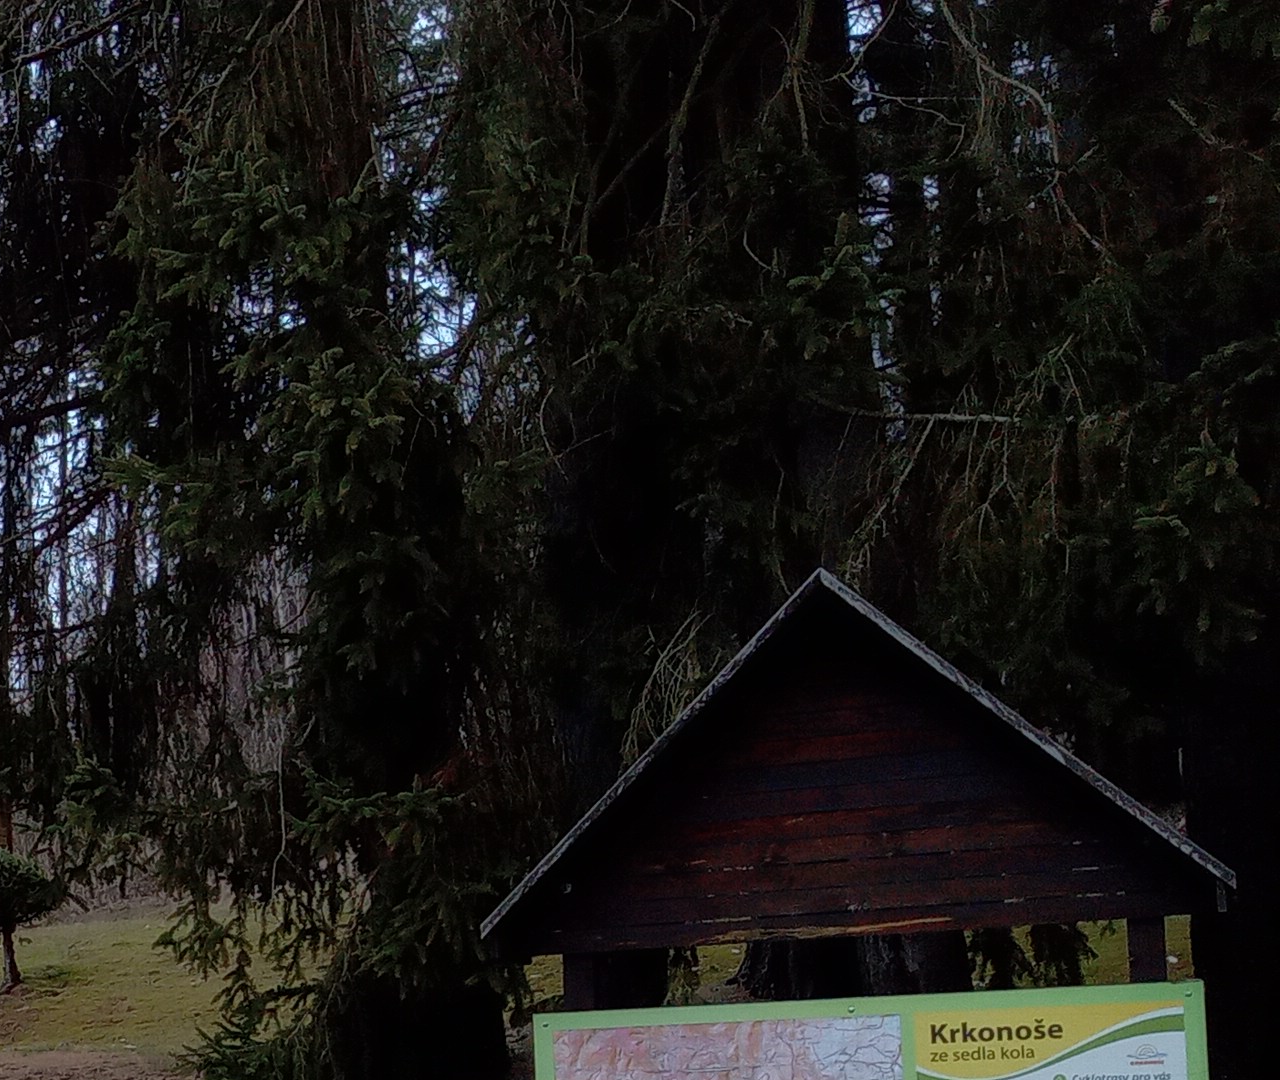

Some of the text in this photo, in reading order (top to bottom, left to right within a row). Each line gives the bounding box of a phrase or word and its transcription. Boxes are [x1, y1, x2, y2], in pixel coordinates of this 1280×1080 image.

[930, 1018, 1064, 1044] Krkonoše
[930, 1045, 1035, 1062] ze sedla kola
[1153, 1071, 1171, 1080] vás
